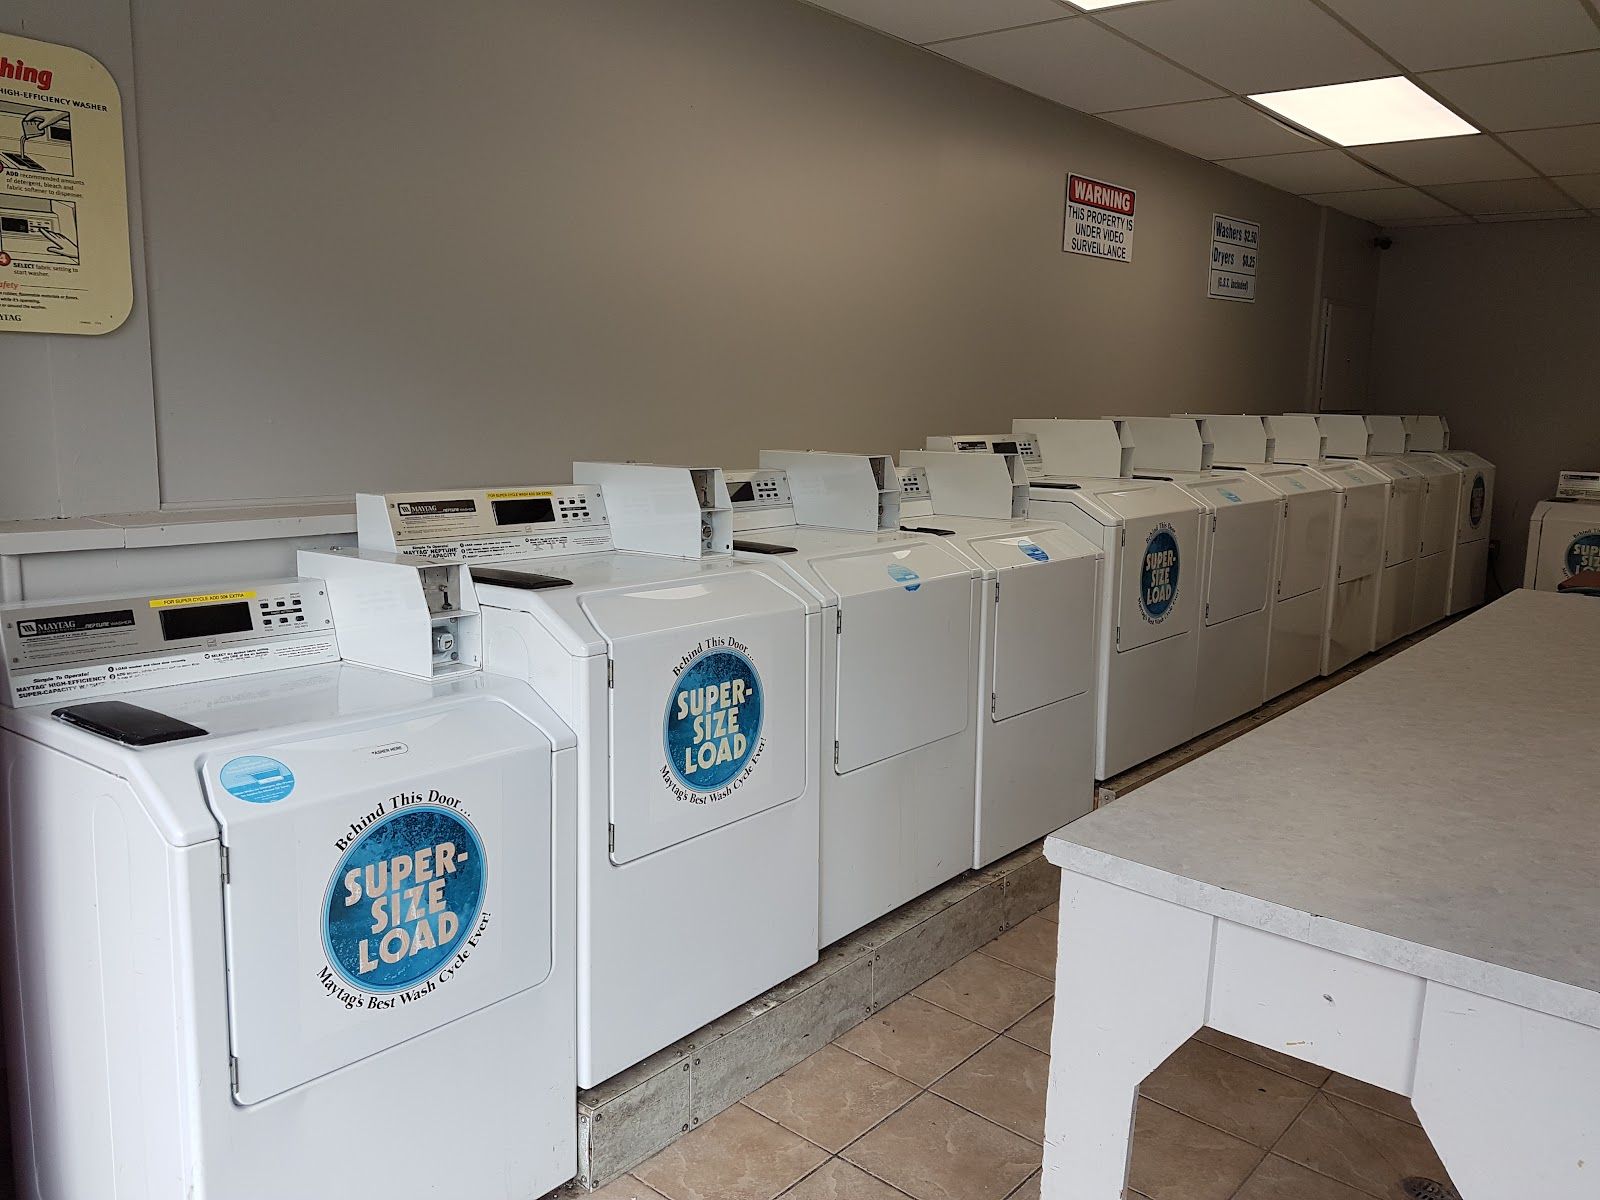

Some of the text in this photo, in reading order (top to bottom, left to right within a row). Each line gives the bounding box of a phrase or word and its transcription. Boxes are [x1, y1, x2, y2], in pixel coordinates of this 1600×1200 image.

[0, 57, 53, 90] hing
[72, 100, 108, 112] WASHER
[14, 178, 43, 187] detergent,
[20, 173, 60, 183] recommended
[1074, 180, 1130, 211] WARNING
[1068, 205, 1133, 231] THIS PROPERTY IS
[1075, 222, 1124, 244] UNDER VIDEO
[1215, 220, 1243, 241] Washers
[1071, 237, 1126, 259] SURVEILLANCE
[1213, 247, 1235, 266] Dryers
[411, 504, 438, 512] MAYTAG
[1146, 549, 1176, 571] SUPER-
[1573, 544, 1600, 557] SUP
[1150, 567, 1170, 588] SIZE
[1146, 584, 1172, 606] LOAD
[38, 620, 76, 631] MAYTAG
[672, 642, 703, 677] Behind
[705, 636, 725, 650] This
[18, 685, 77, 699] SUPER-CAPACITY
[48, 675, 107, 688] HIGH-EFFICIENCY
[677, 678, 753, 721] SUPER-
[693, 707, 740, 745] SIZE
[684, 733, 747, 775] LOAD
[660, 737, 767, 805] Maytag's Best Wash Cycle Ever!
[334, 802, 386, 852] Behind
[389, 790, 423, 810] This
[344, 841, 469, 907] SUPER-
[371, 877, 447, 934] SIZE
[358, 911, 459, 975] LOAD
[316, 911, 491, 1010] Maytag's Best Wash Cycle Ever!
